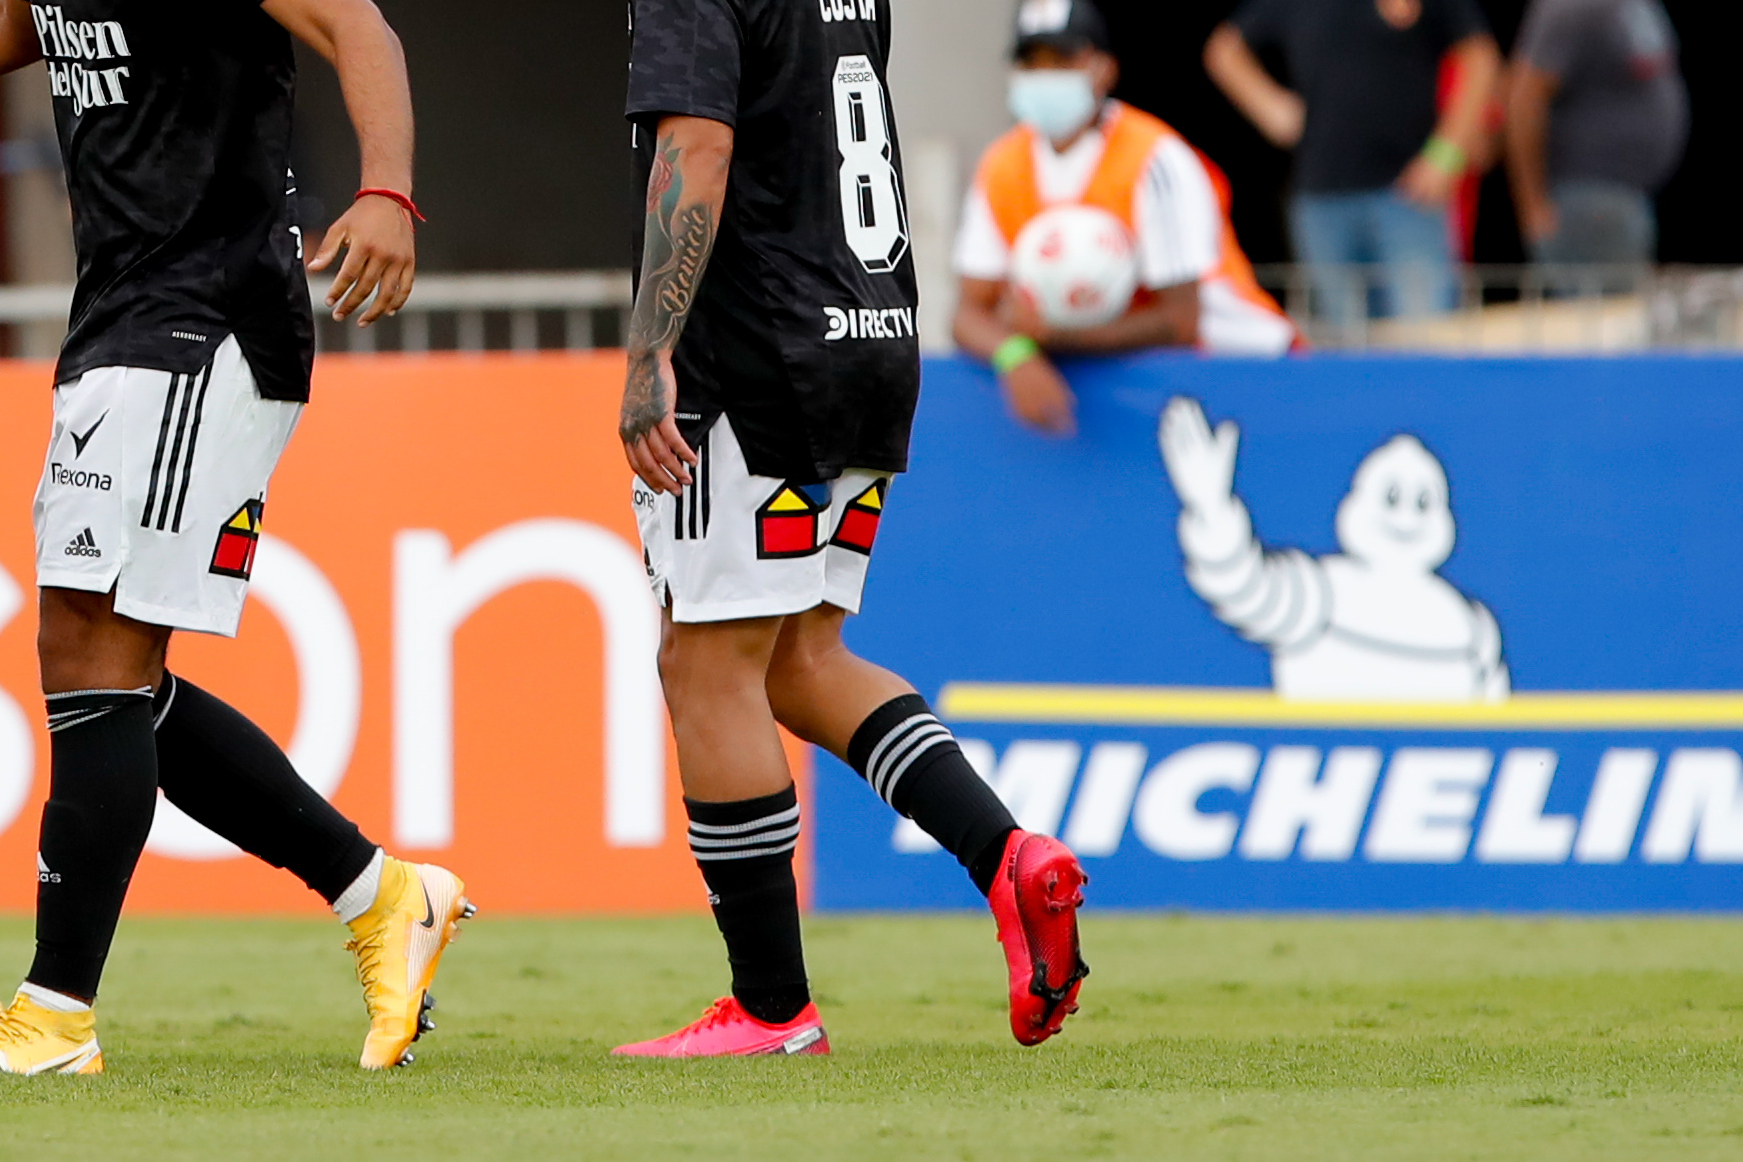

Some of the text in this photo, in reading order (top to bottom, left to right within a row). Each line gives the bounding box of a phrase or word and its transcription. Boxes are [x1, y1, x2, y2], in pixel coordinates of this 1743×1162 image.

[30, 4, 132, 60] Pilsen
[71, 62, 130, 117] Sur
[837, 71, 874, 84] PES2021
[831, 54, 909, 274] 8
[823, 306, 914, 341] DIRECTV
[51, 462, 113, 491] Rexona
